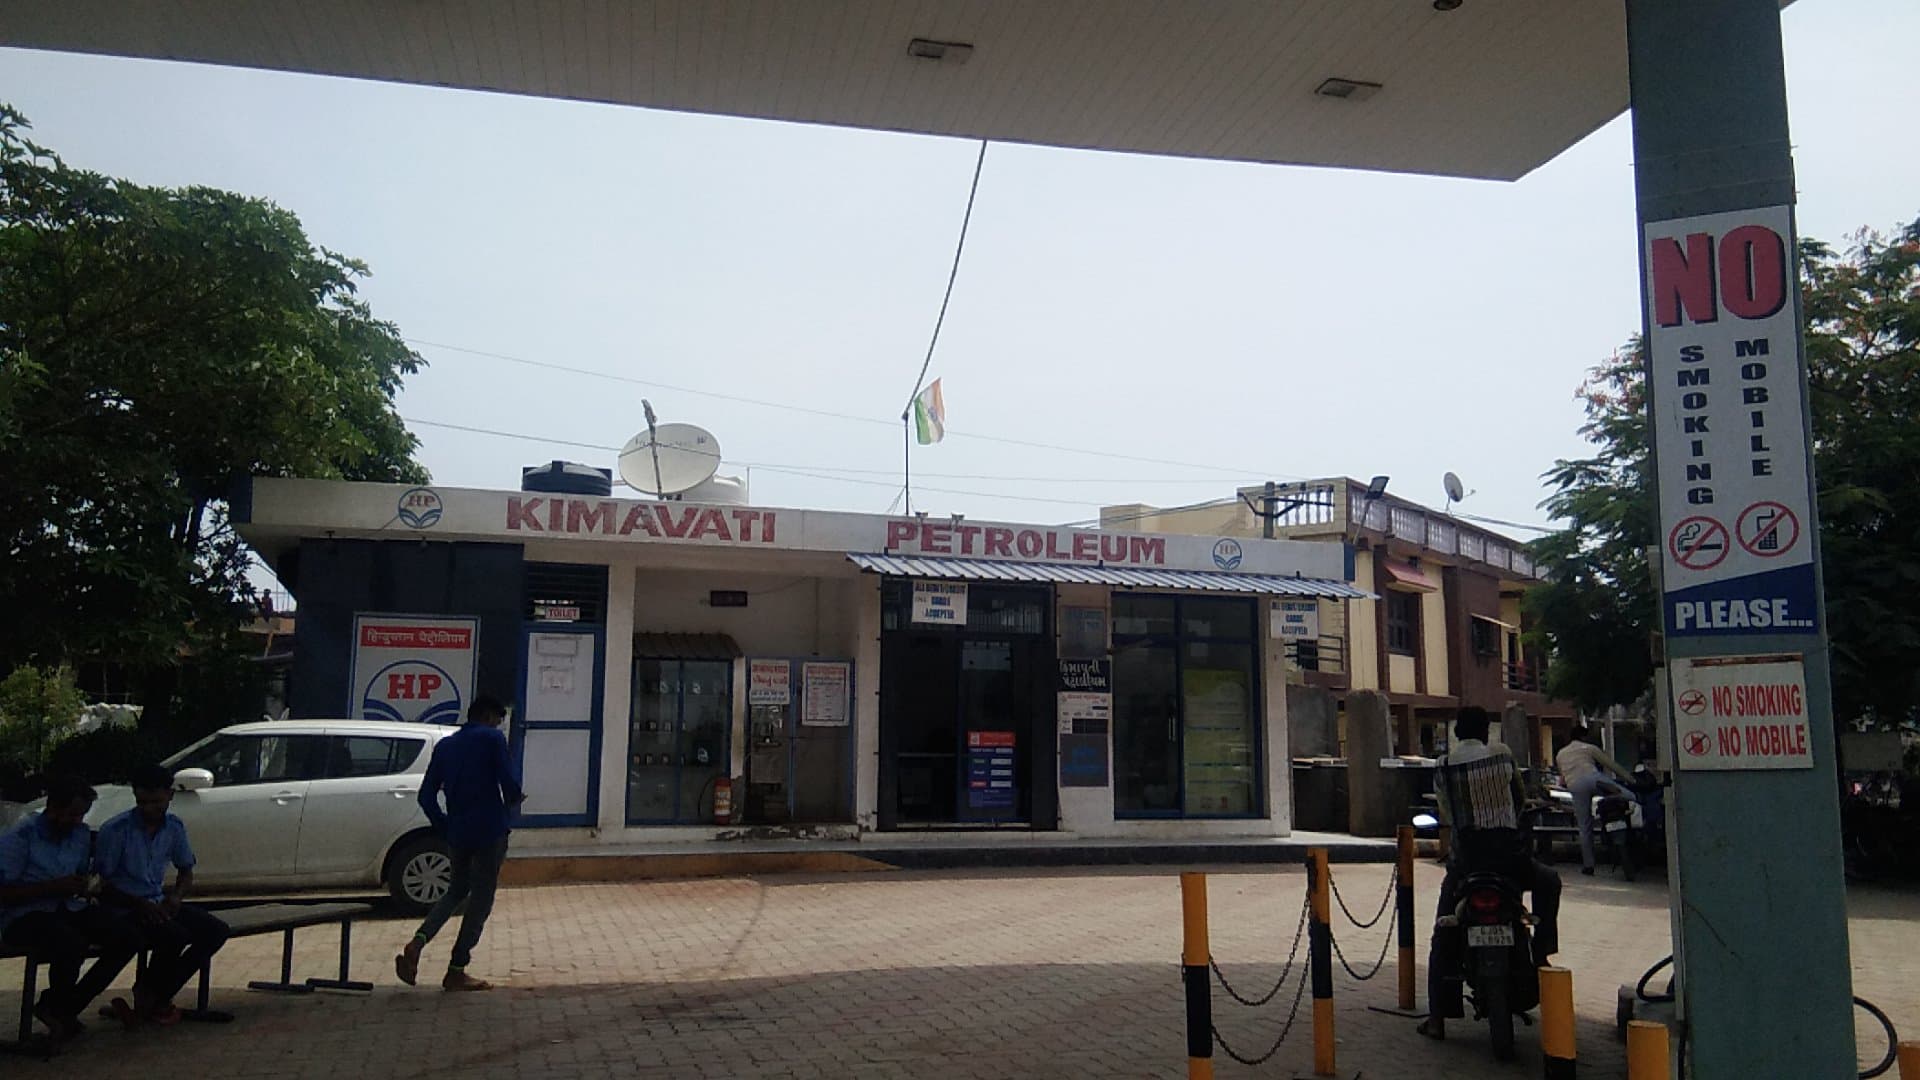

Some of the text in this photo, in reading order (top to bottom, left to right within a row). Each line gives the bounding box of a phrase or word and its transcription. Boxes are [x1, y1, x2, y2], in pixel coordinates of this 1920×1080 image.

[1651, 225, 1787, 328] NO
[1677, 345, 1714, 505] SMOKING
[1735, 338, 1773, 477] MOBILE
[506, 496, 1166, 565] KIMAVATI PETROLEUM
[1675, 598, 1814, 630] PLEASE...
[387, 674, 442, 699] HP
[1712, 684, 1802, 717] NO SMOKING
[1718, 723, 1807, 757] NO MOBILE
